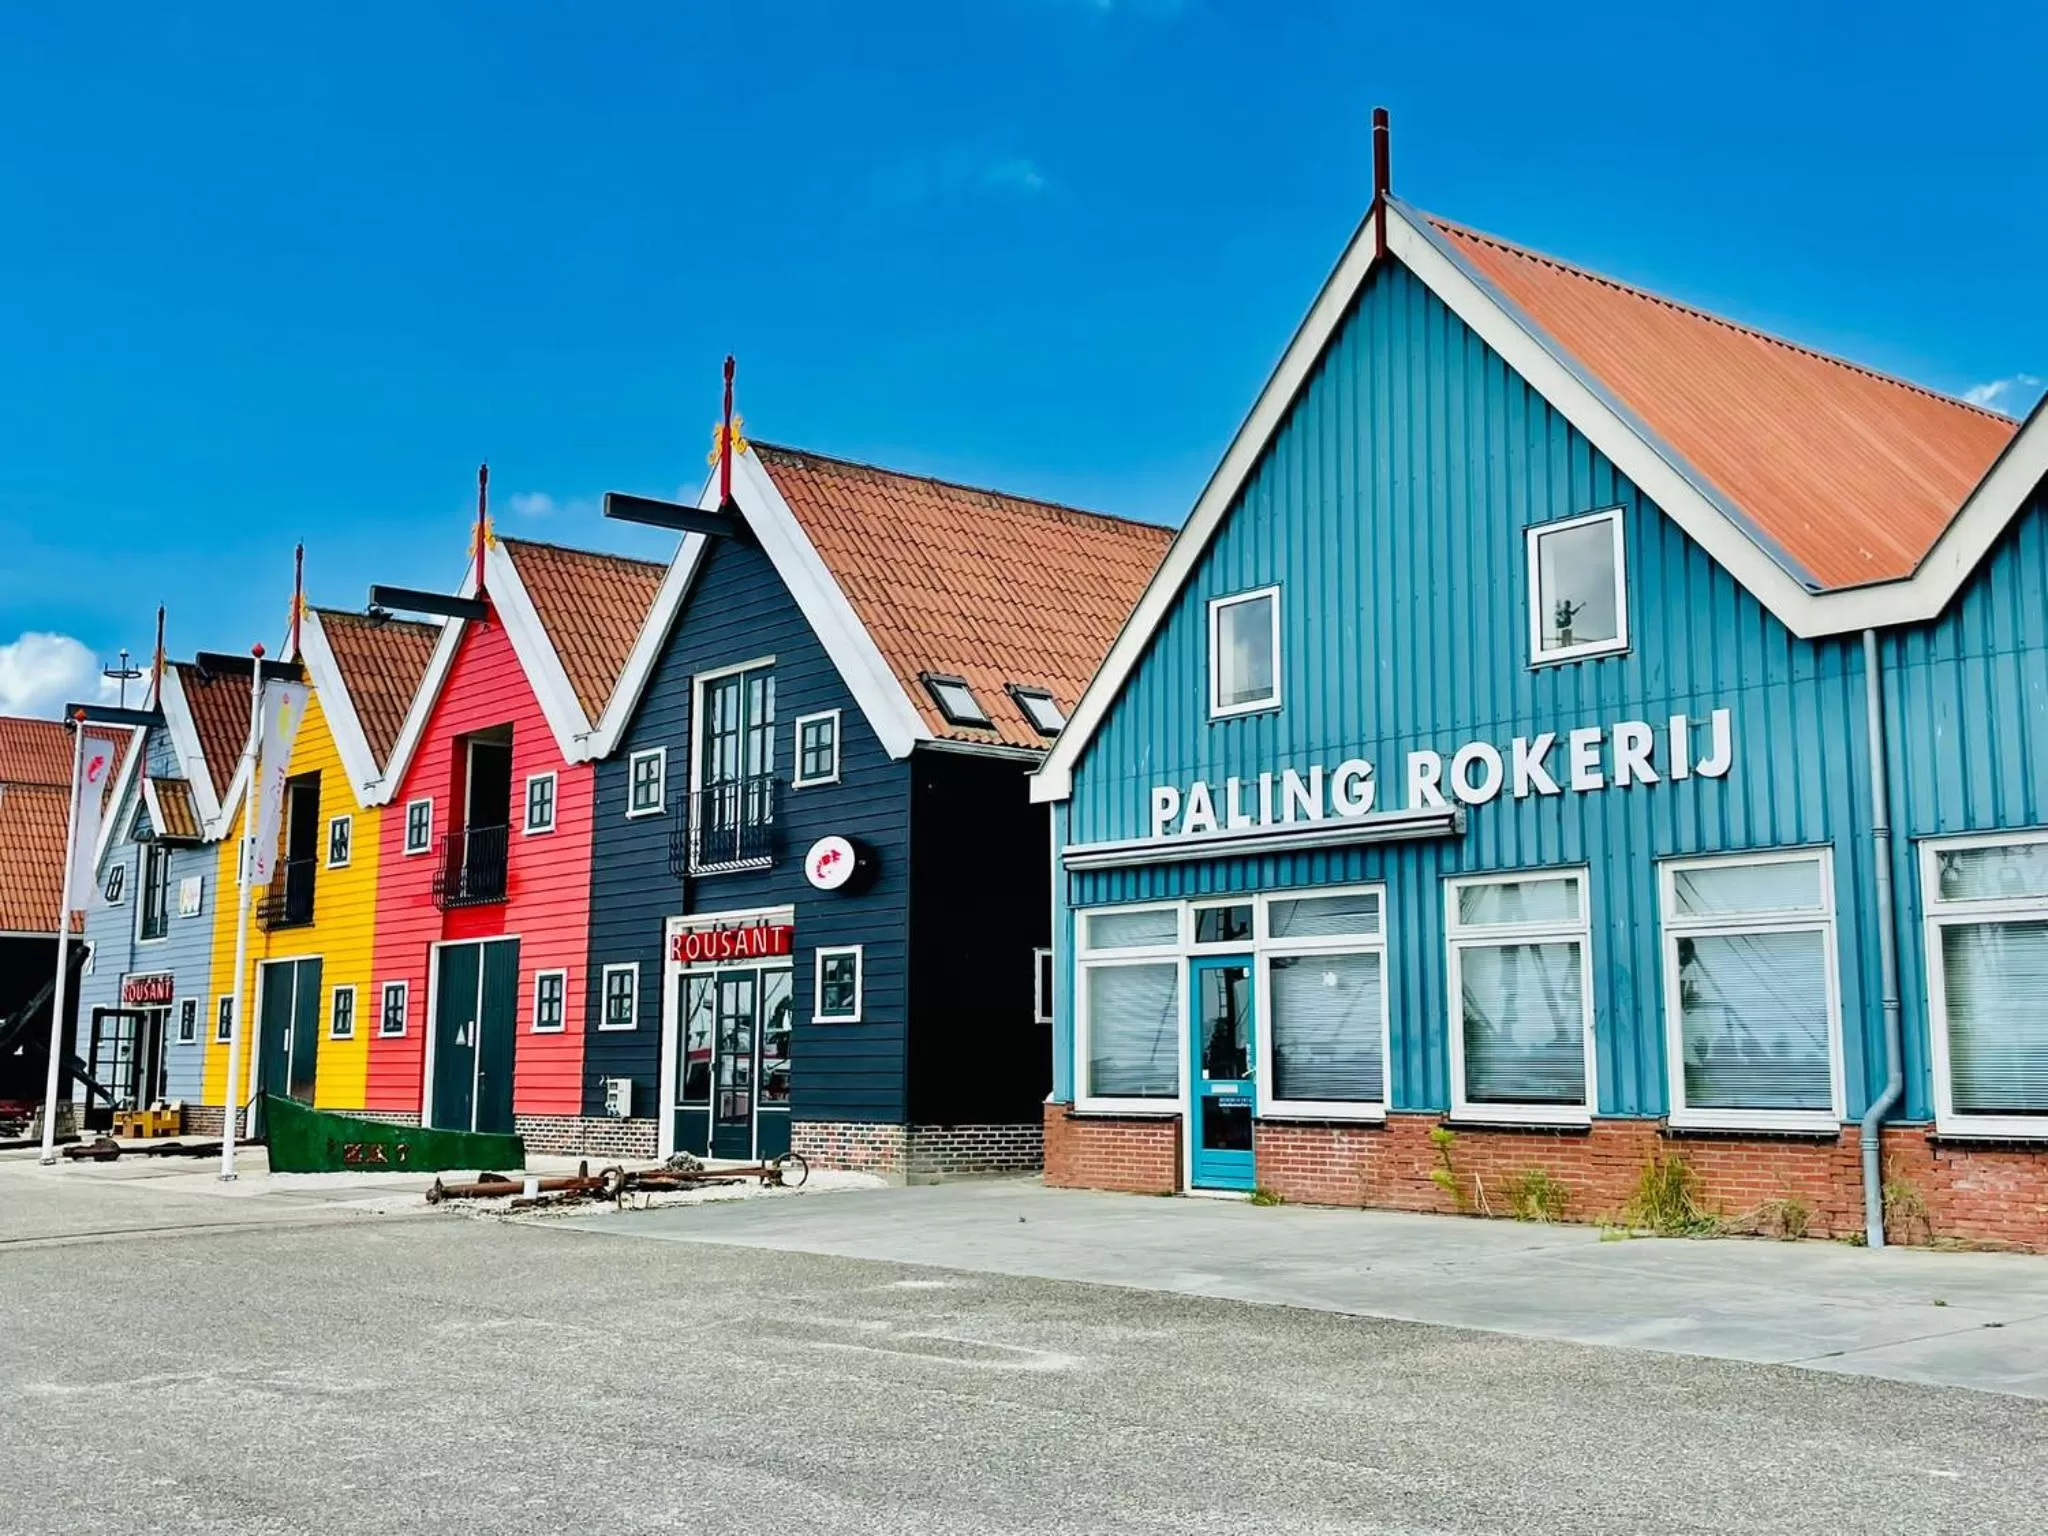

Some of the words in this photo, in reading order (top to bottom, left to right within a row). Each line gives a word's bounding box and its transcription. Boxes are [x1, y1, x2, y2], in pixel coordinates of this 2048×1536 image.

[1151, 759, 1376, 838] PALING
[1407, 708, 1732, 808] ROKERIJ
[671, 926, 785, 960] ROUSANT
